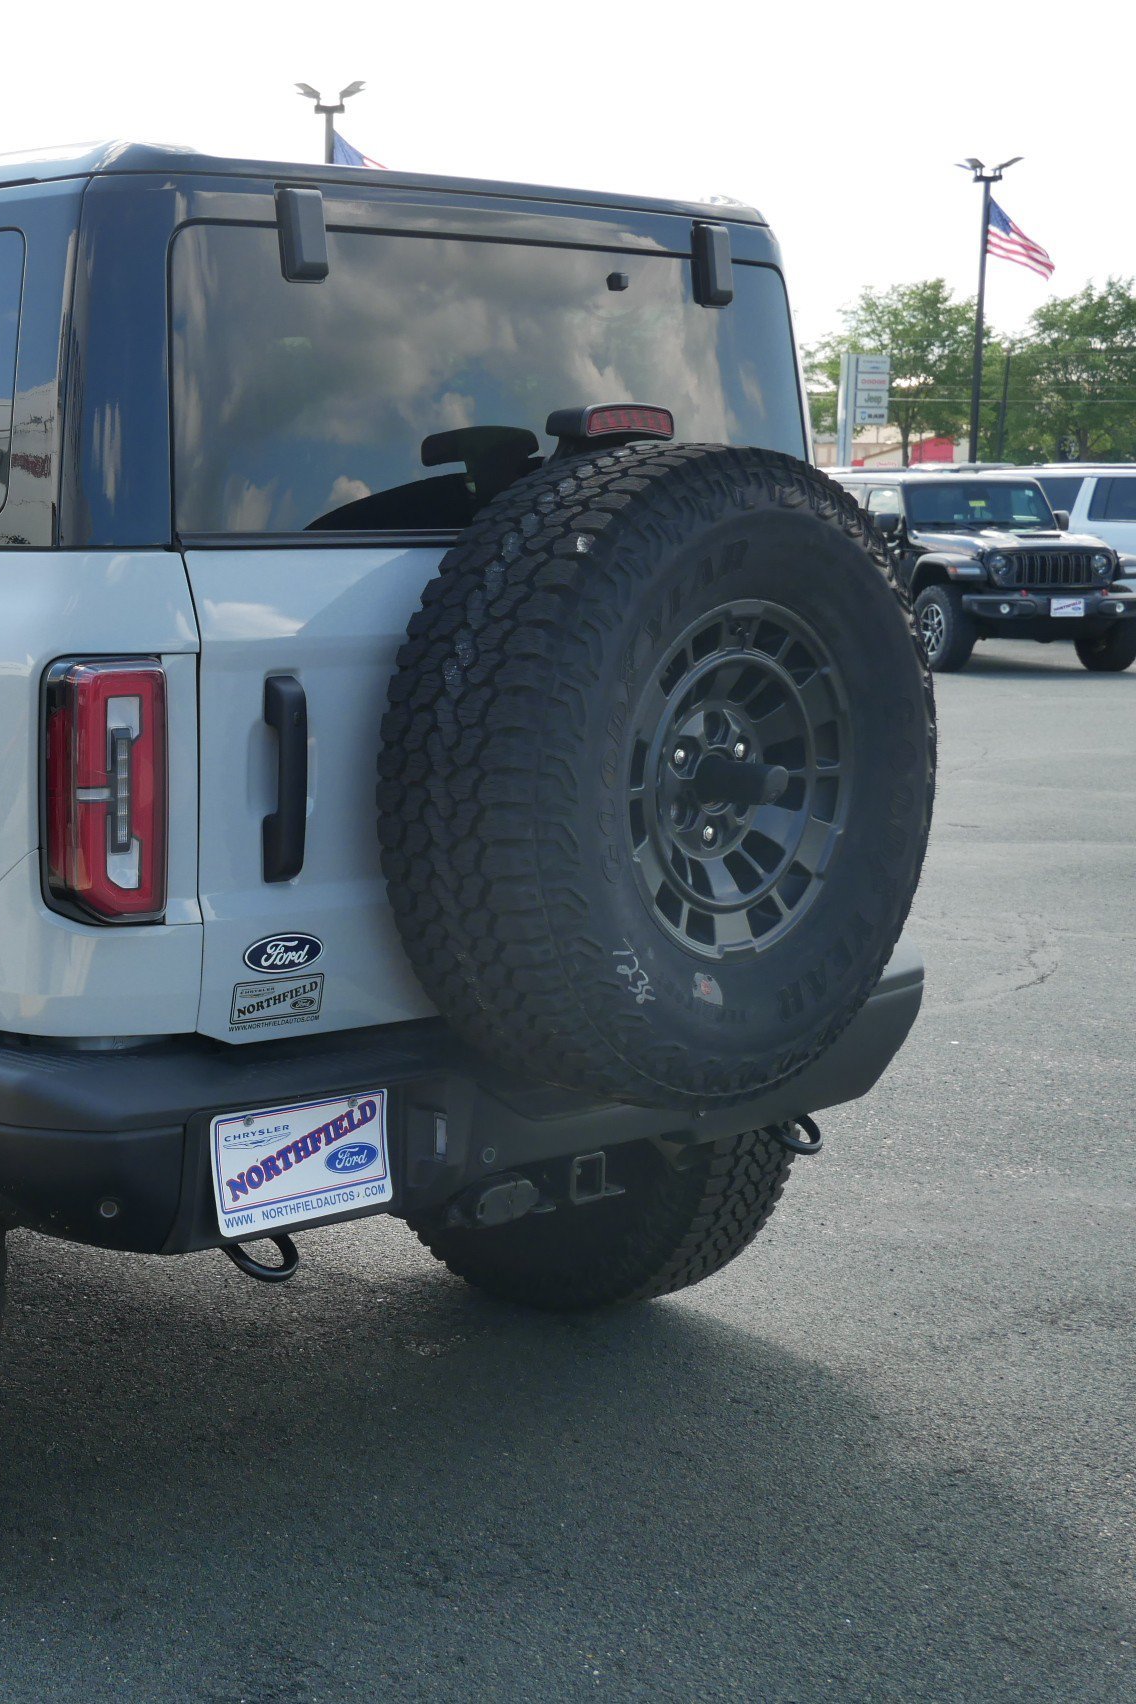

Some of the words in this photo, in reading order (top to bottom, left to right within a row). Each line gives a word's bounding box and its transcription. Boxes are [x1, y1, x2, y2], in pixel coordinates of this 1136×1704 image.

[864, 393, 882, 406] Jeep
[261, 940, 310, 967] Ford
[236, 980, 319, 1018] NORTHFIELD
[228, 1015, 320, 1032] WWW.NORTHFIELDAUTOS.COM
[224, 1124, 290, 1143] CHRYSLER
[225, 1099, 377, 1202] NORTHFIELD
[335, 1147, 368, 1169] Ford
[224, 1213, 256, 1229] WWW.
[262, 1190, 355, 1221] NORTHFIELDAUTOS
